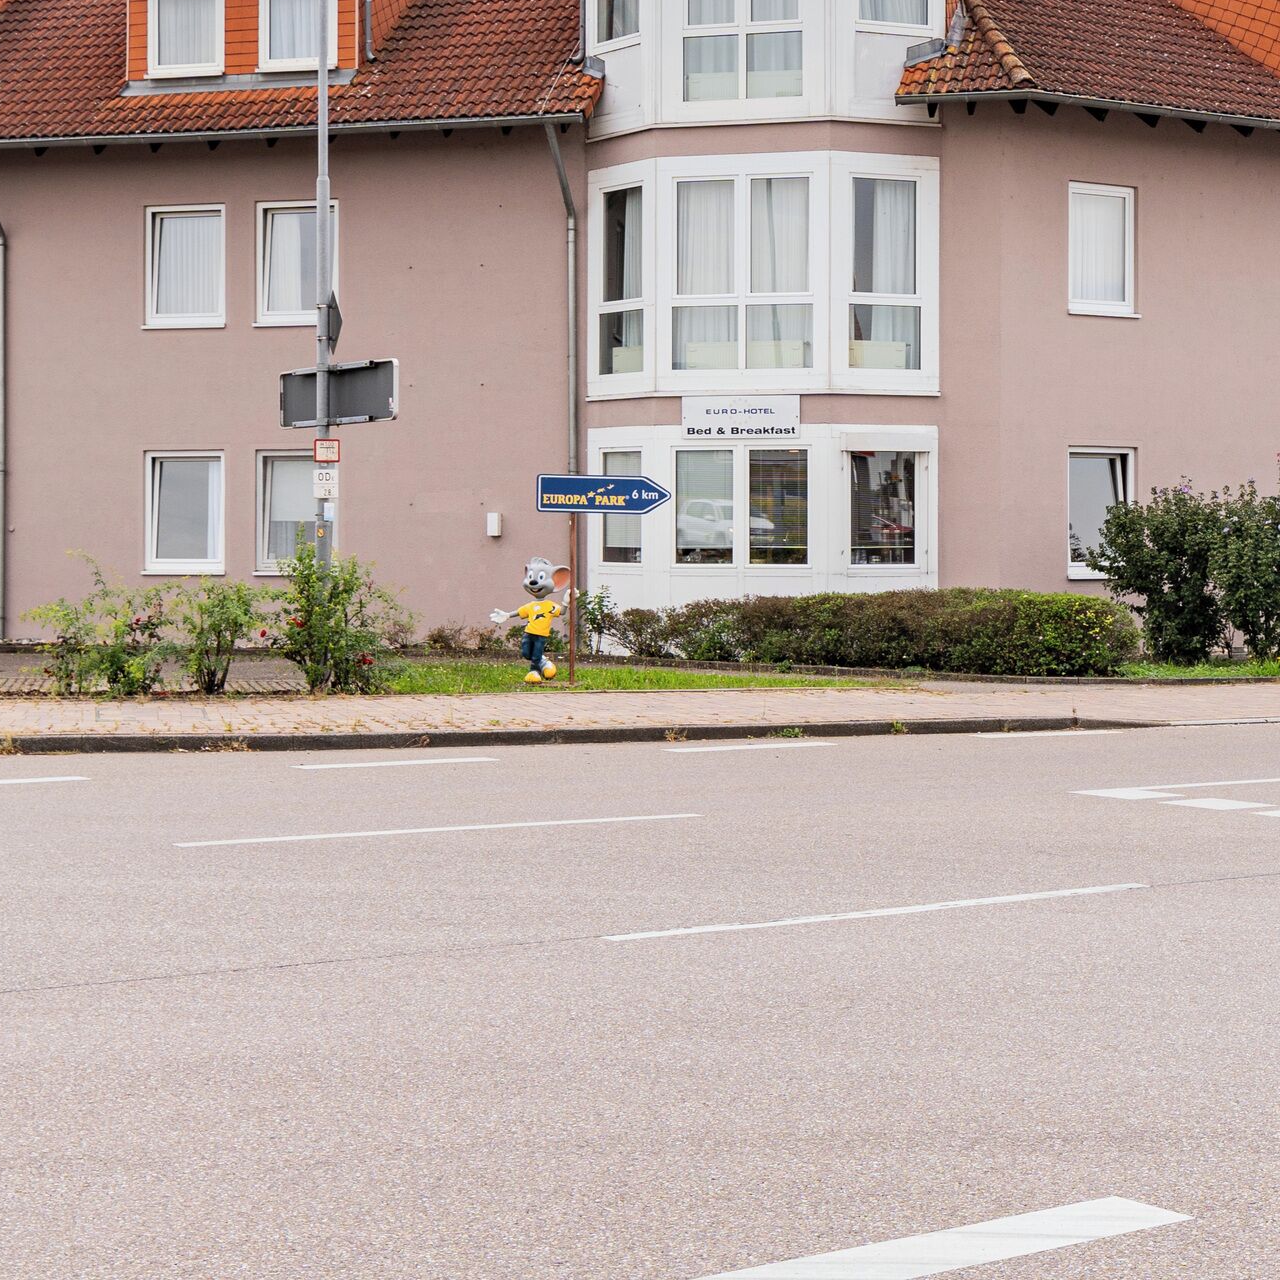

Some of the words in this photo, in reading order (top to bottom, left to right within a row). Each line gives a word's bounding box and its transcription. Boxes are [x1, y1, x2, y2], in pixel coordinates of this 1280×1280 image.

[687, 426, 712, 435] Bed
[716, 426, 726, 435] &
[730, 425, 796, 435] Breakfast
[543, 493, 588, 505] EUROPA
[631, 489, 639, 500] 6
[641, 489, 659, 500] km
